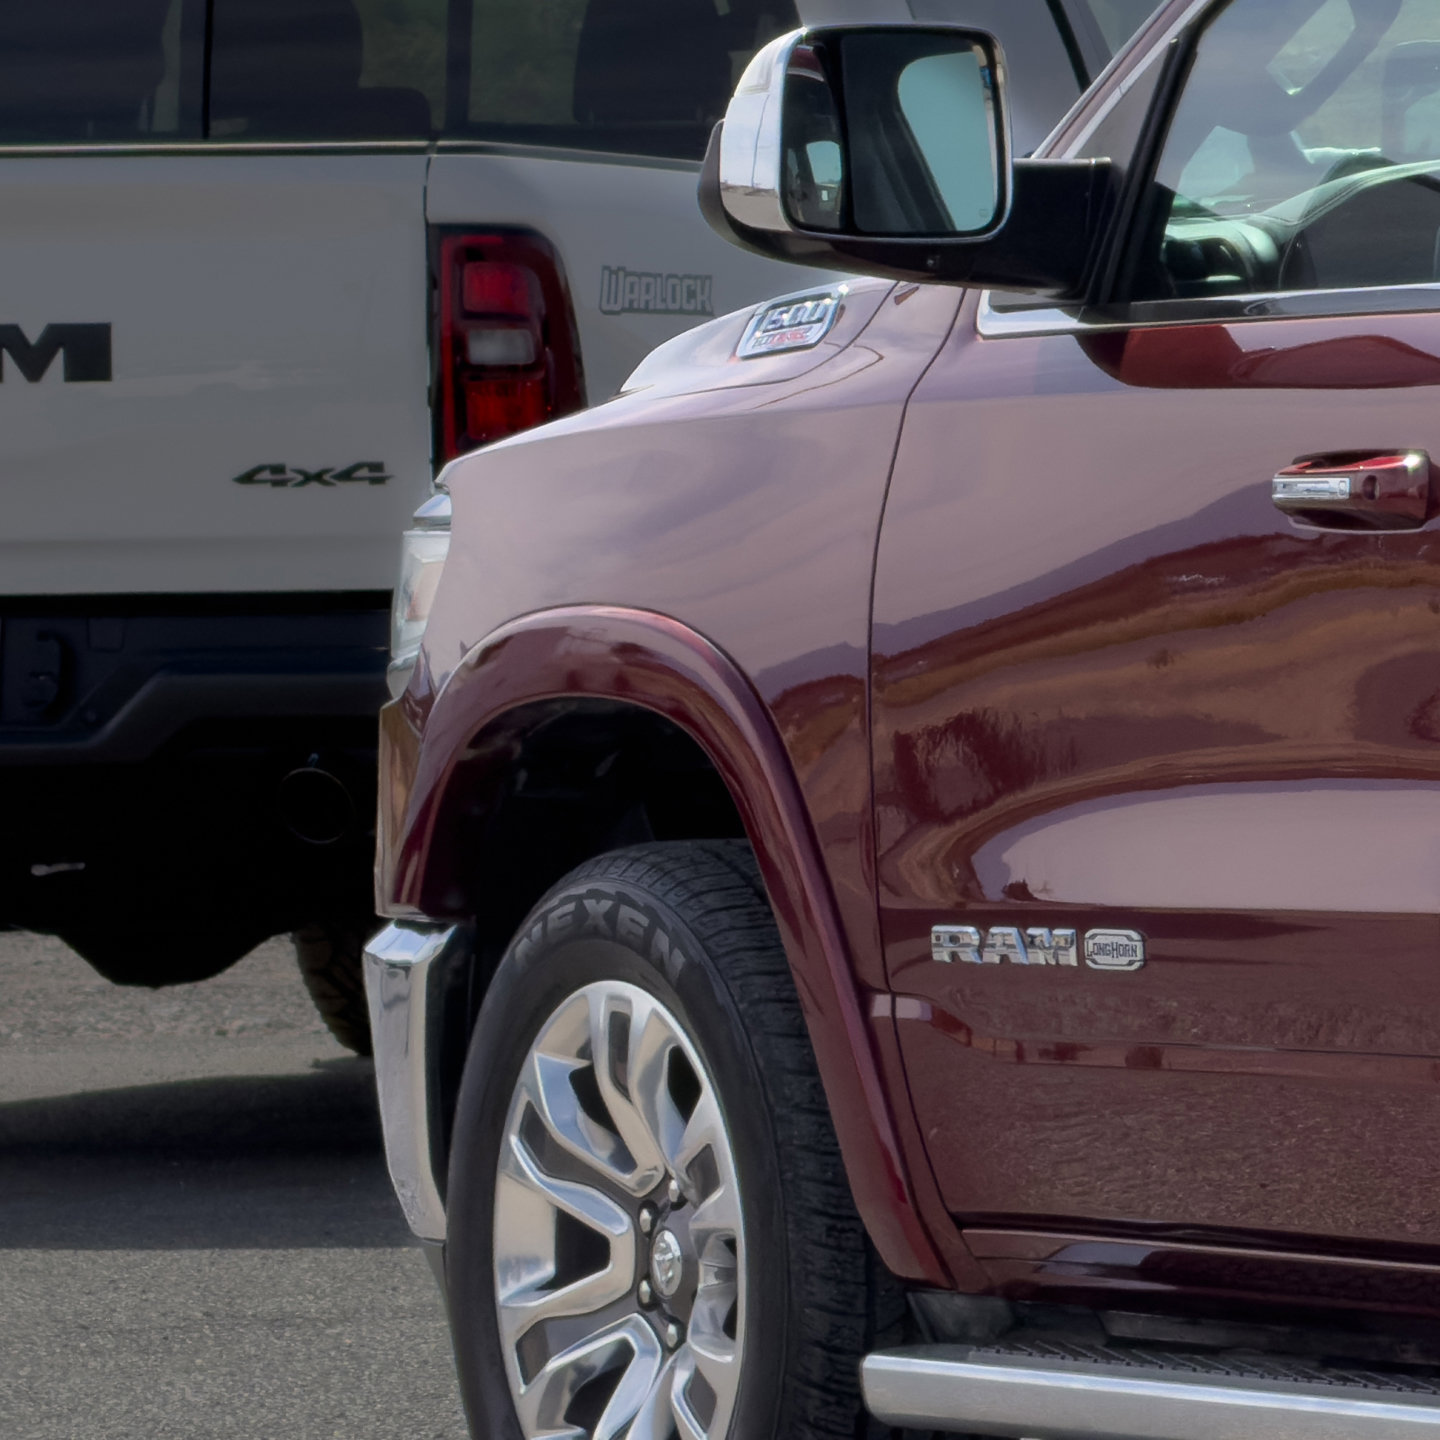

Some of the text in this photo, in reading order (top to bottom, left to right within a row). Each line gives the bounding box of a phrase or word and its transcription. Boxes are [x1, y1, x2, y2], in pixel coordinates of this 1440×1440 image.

[601, 265, 714, 316] WARLOCK
[232, 461, 394, 488] 4x4
[514, 897, 687, 986] NEXEN
[931, 925, 1079, 967] RAM
